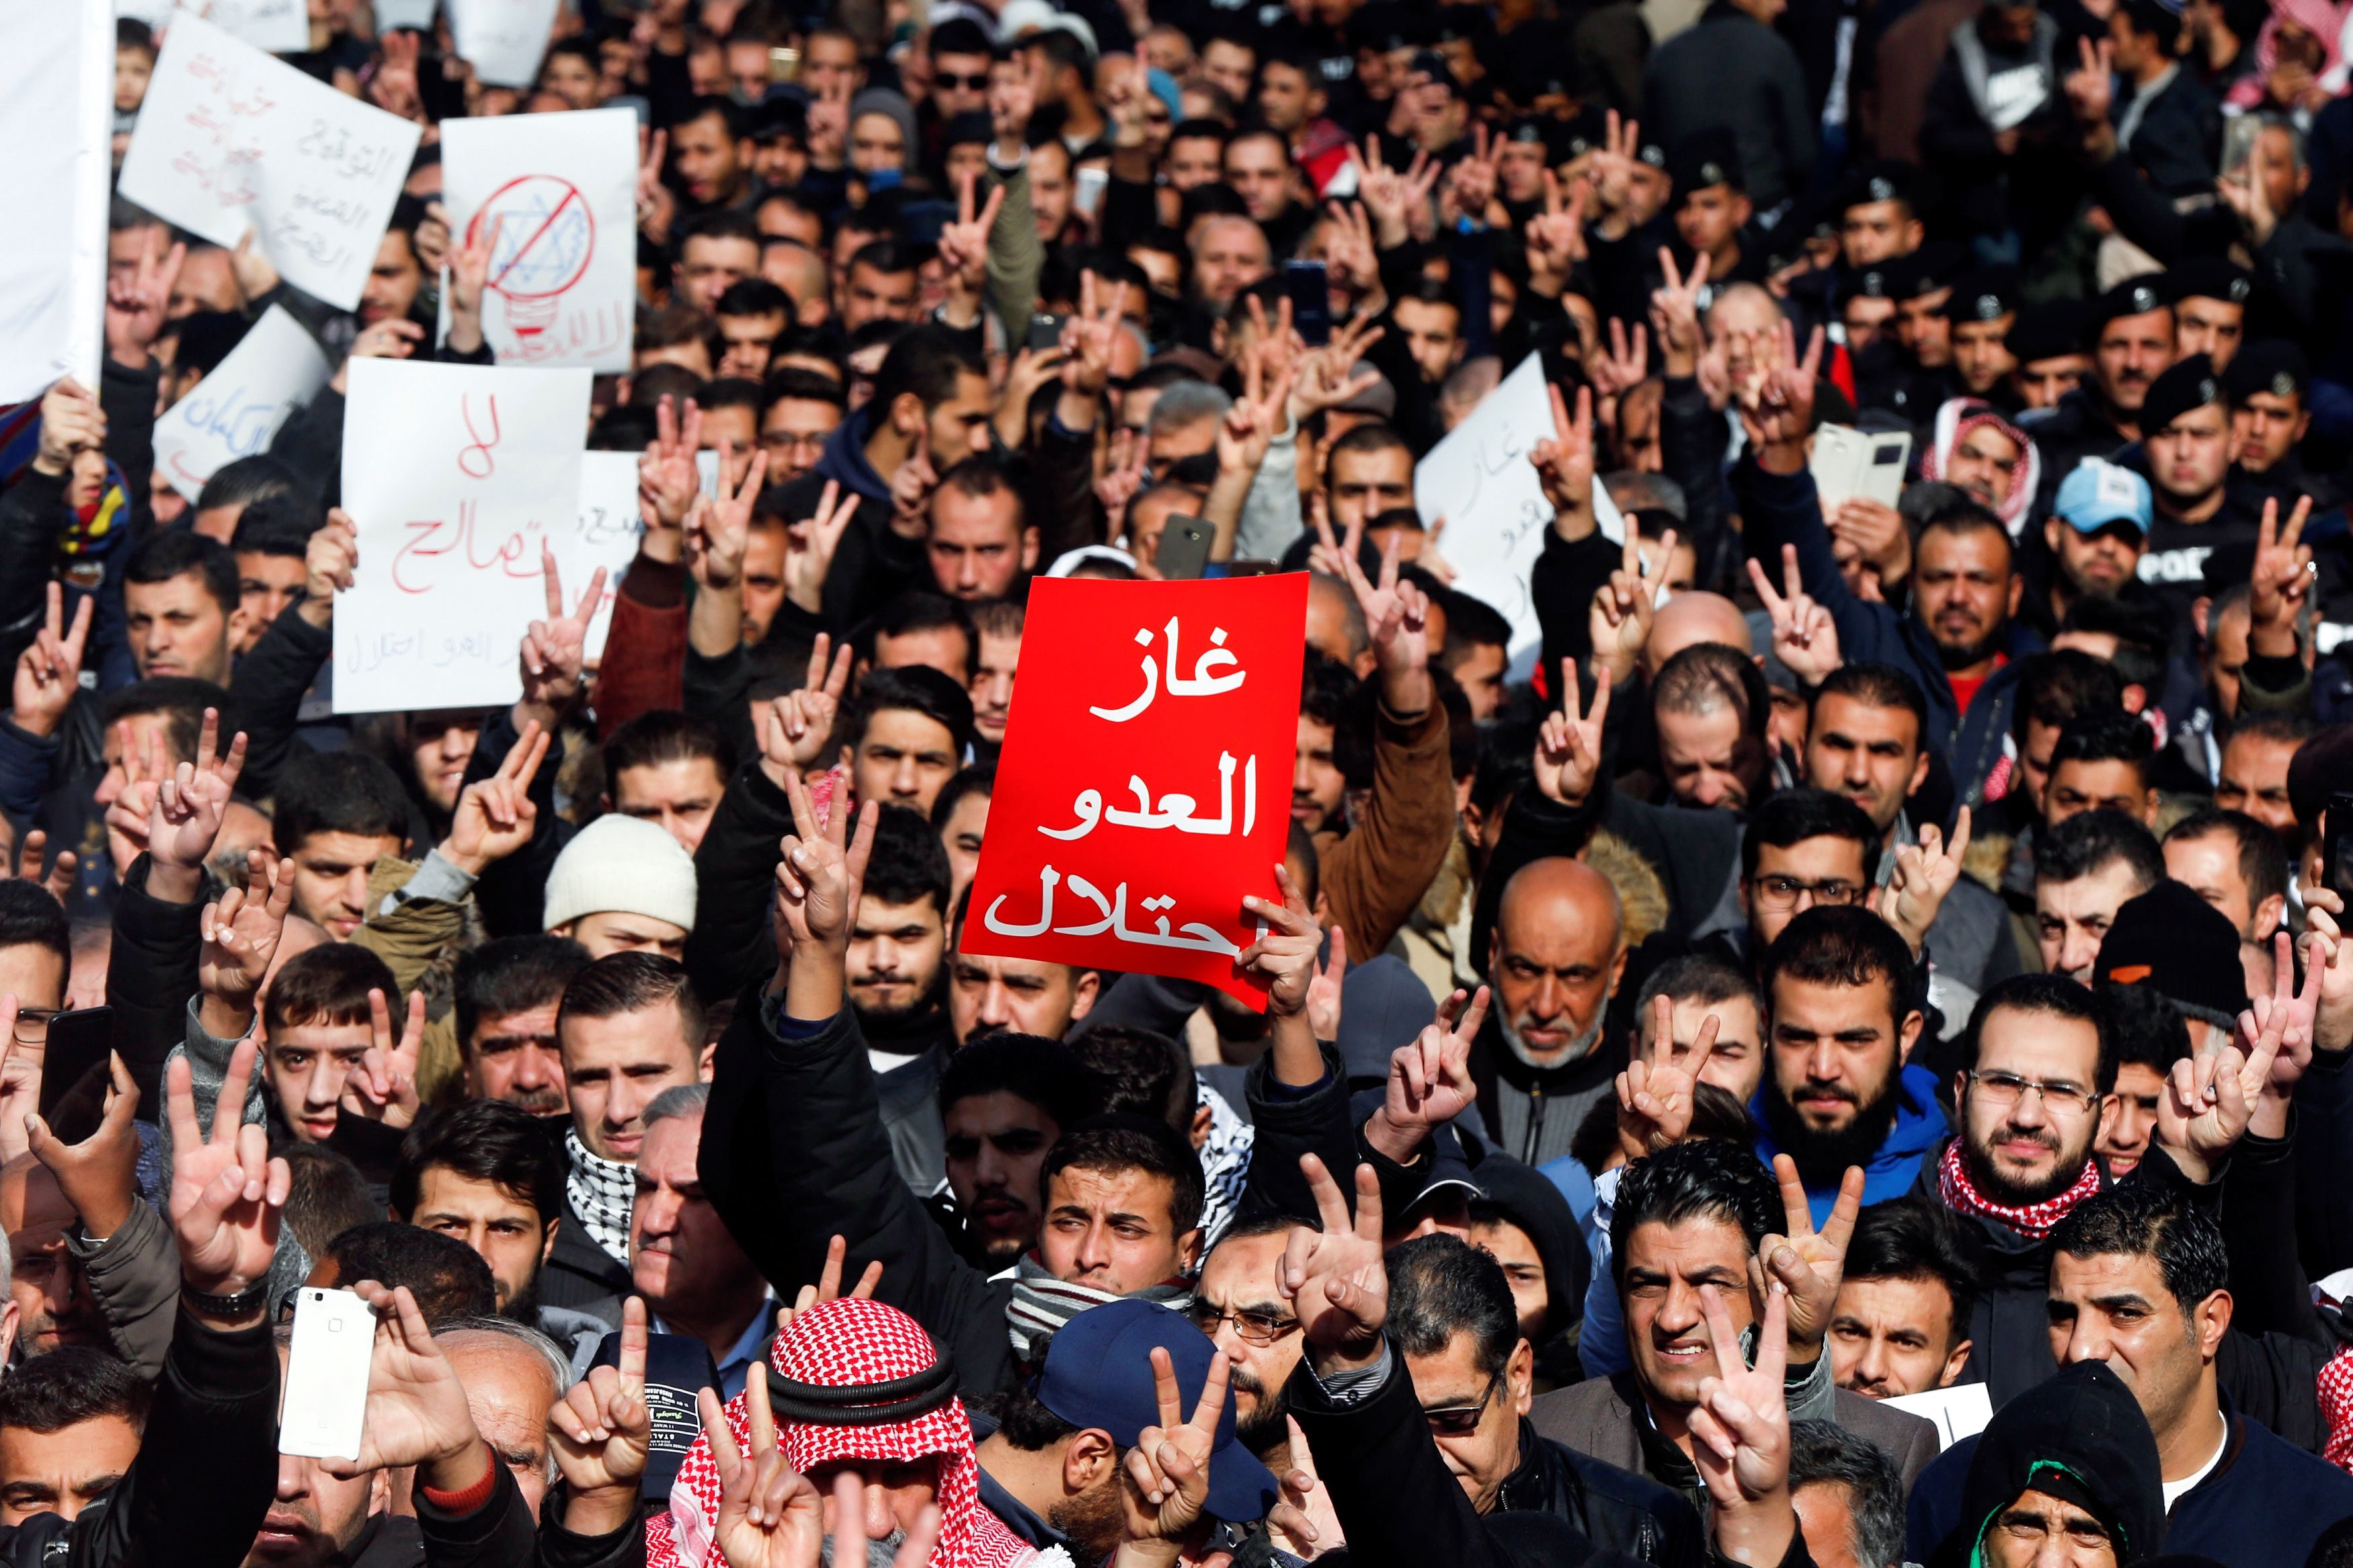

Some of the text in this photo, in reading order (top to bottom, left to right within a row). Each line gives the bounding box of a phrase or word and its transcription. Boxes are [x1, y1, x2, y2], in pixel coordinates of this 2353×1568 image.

[458, 393, 501, 479] لا
[392, 499, 548, 593] تصالح
[1089, 616, 1246, 723] غاز
[1037, 750, 1257, 841] العدو
